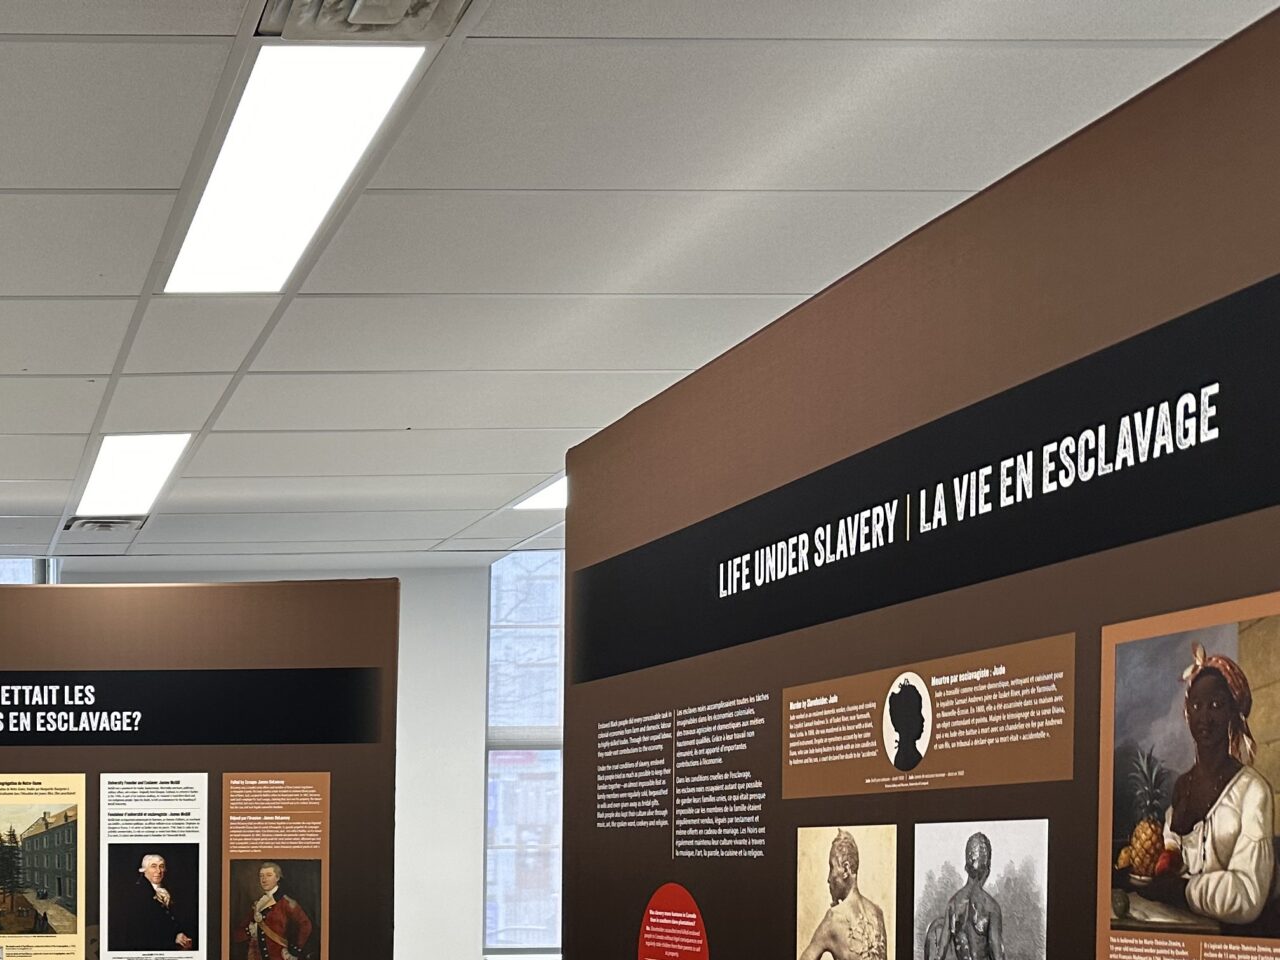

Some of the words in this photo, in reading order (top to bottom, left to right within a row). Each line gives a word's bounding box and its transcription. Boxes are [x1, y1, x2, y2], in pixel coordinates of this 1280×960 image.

[920, 483, 947, 533] LA
[954, 466, 992, 521] VIE
[1000, 451, 1033, 508] EN
[1043, 383, 1219, 494] ESCLAVAGE
[719, 553, 751, 598] LIFE
[755, 532, 809, 588] UNDER
[814, 500, 898, 567] SLAVERY
[931, 673, 949, 686] Meurtre
[950, 672, 958, 683] par
[992, 666, 1005, 678] Jude
[65, 686, 95, 705] LES
[9, 712, 30, 732] EN
[36, 711, 141, 732] ESCLAVAGE?
